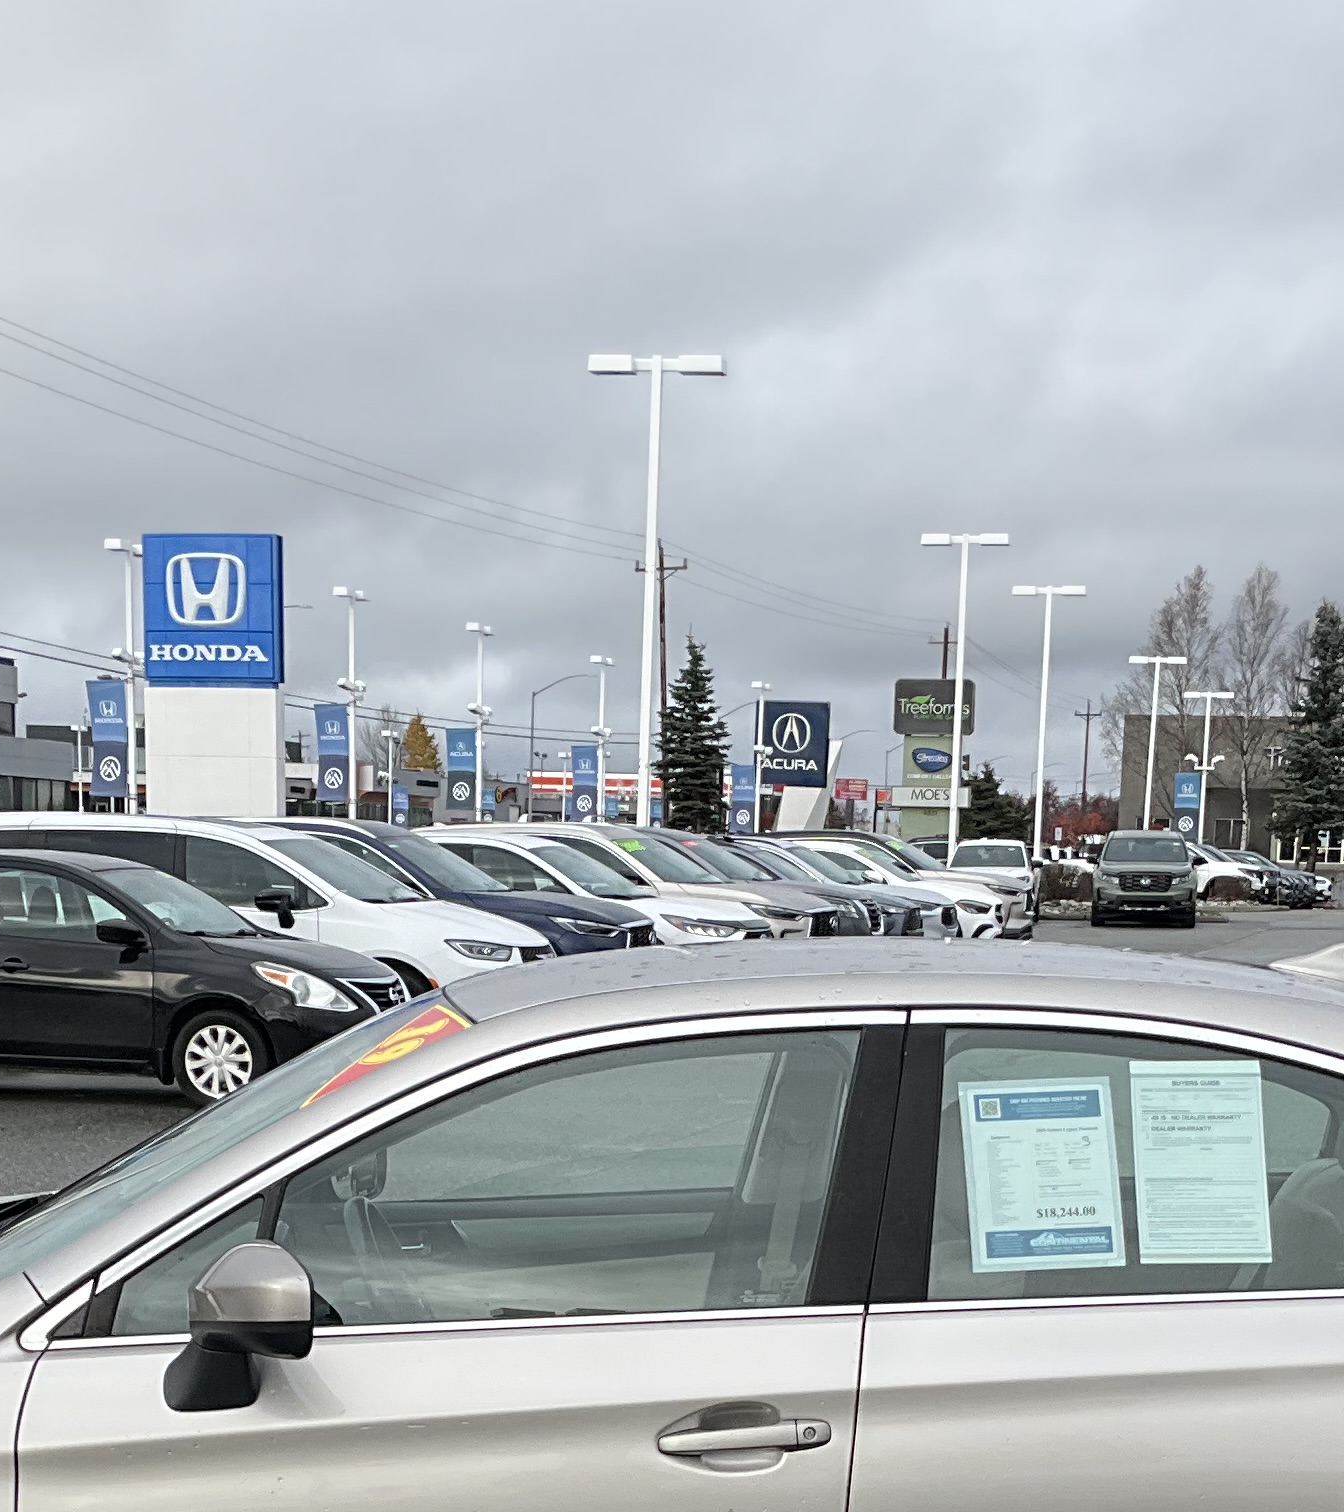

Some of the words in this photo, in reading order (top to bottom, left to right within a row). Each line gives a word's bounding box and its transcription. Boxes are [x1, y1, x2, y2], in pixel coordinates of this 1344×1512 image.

[149, 644, 269, 662] HONDA
[761, 758, 818, 771] ACURA
[911, 788, 950, 801] MOE'S
[1036, 1206, 1096, 1220] $18,244.00
